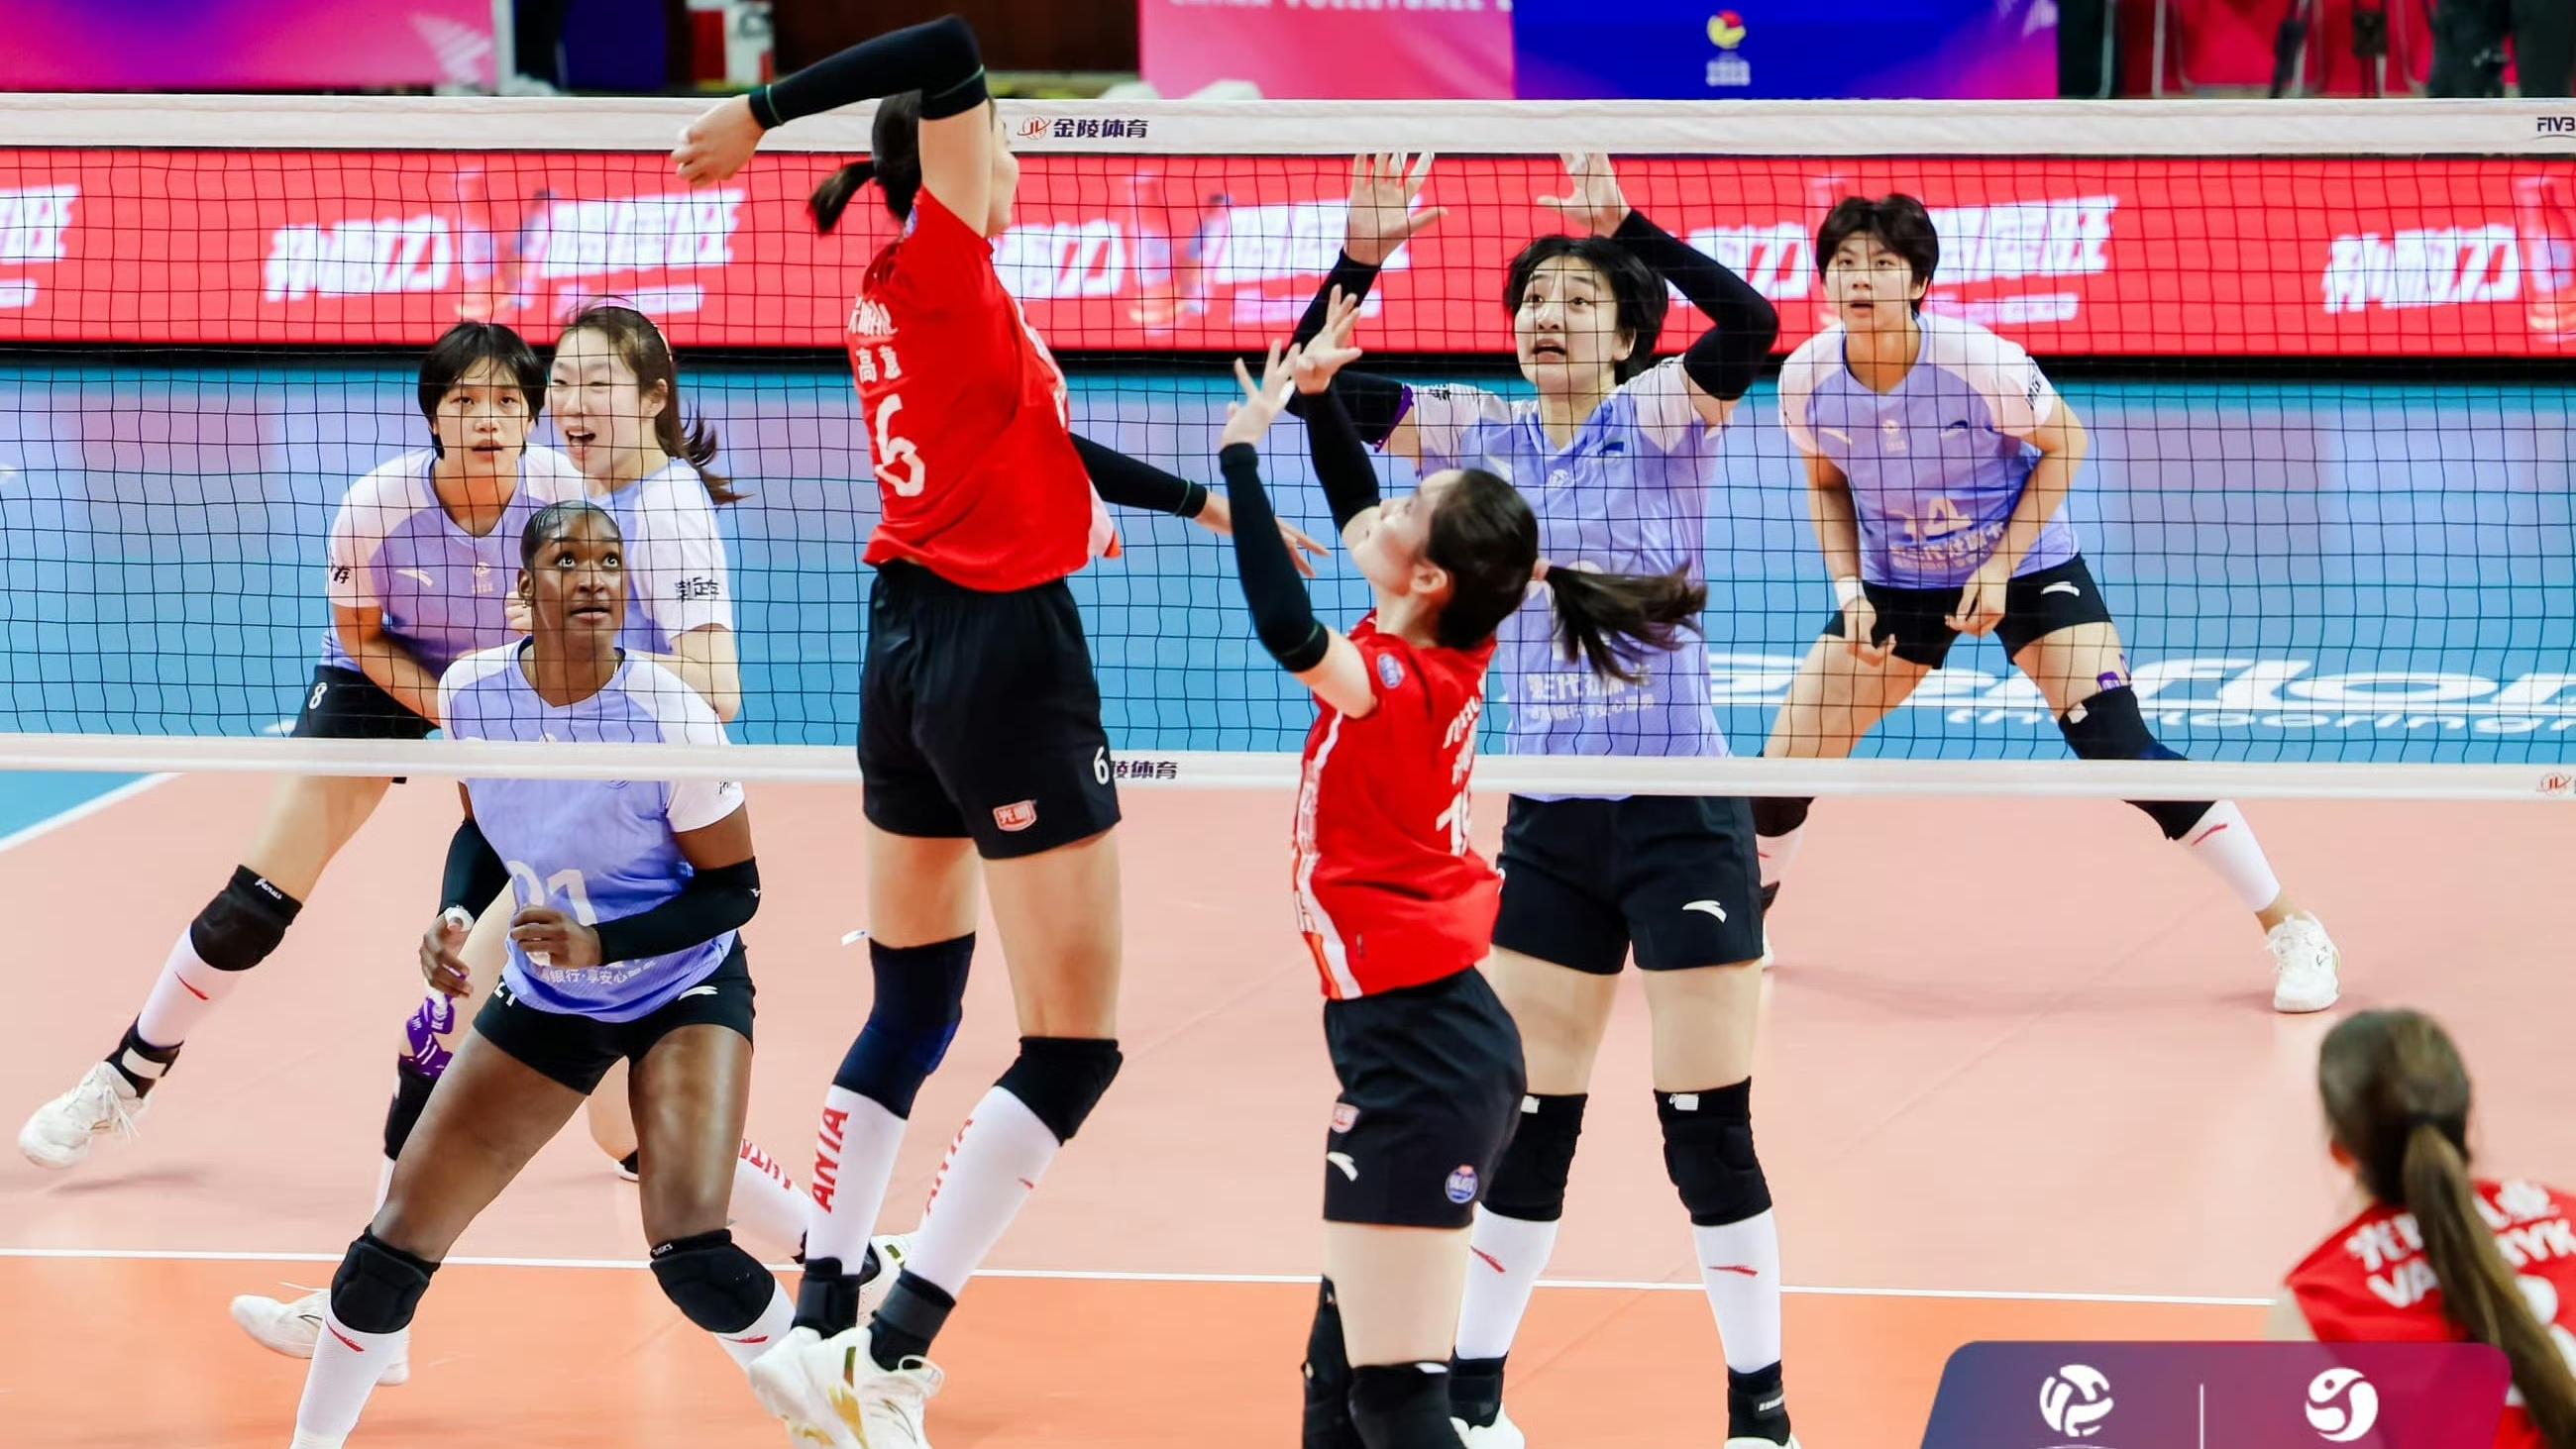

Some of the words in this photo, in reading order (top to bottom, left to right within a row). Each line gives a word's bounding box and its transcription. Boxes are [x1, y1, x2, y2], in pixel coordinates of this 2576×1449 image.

[1053, 118, 1149, 139] 金陵体育
[874, 392, 926, 497] 6
[308, 681, 328, 710] 8
[1093, 745, 1110, 785] 6
